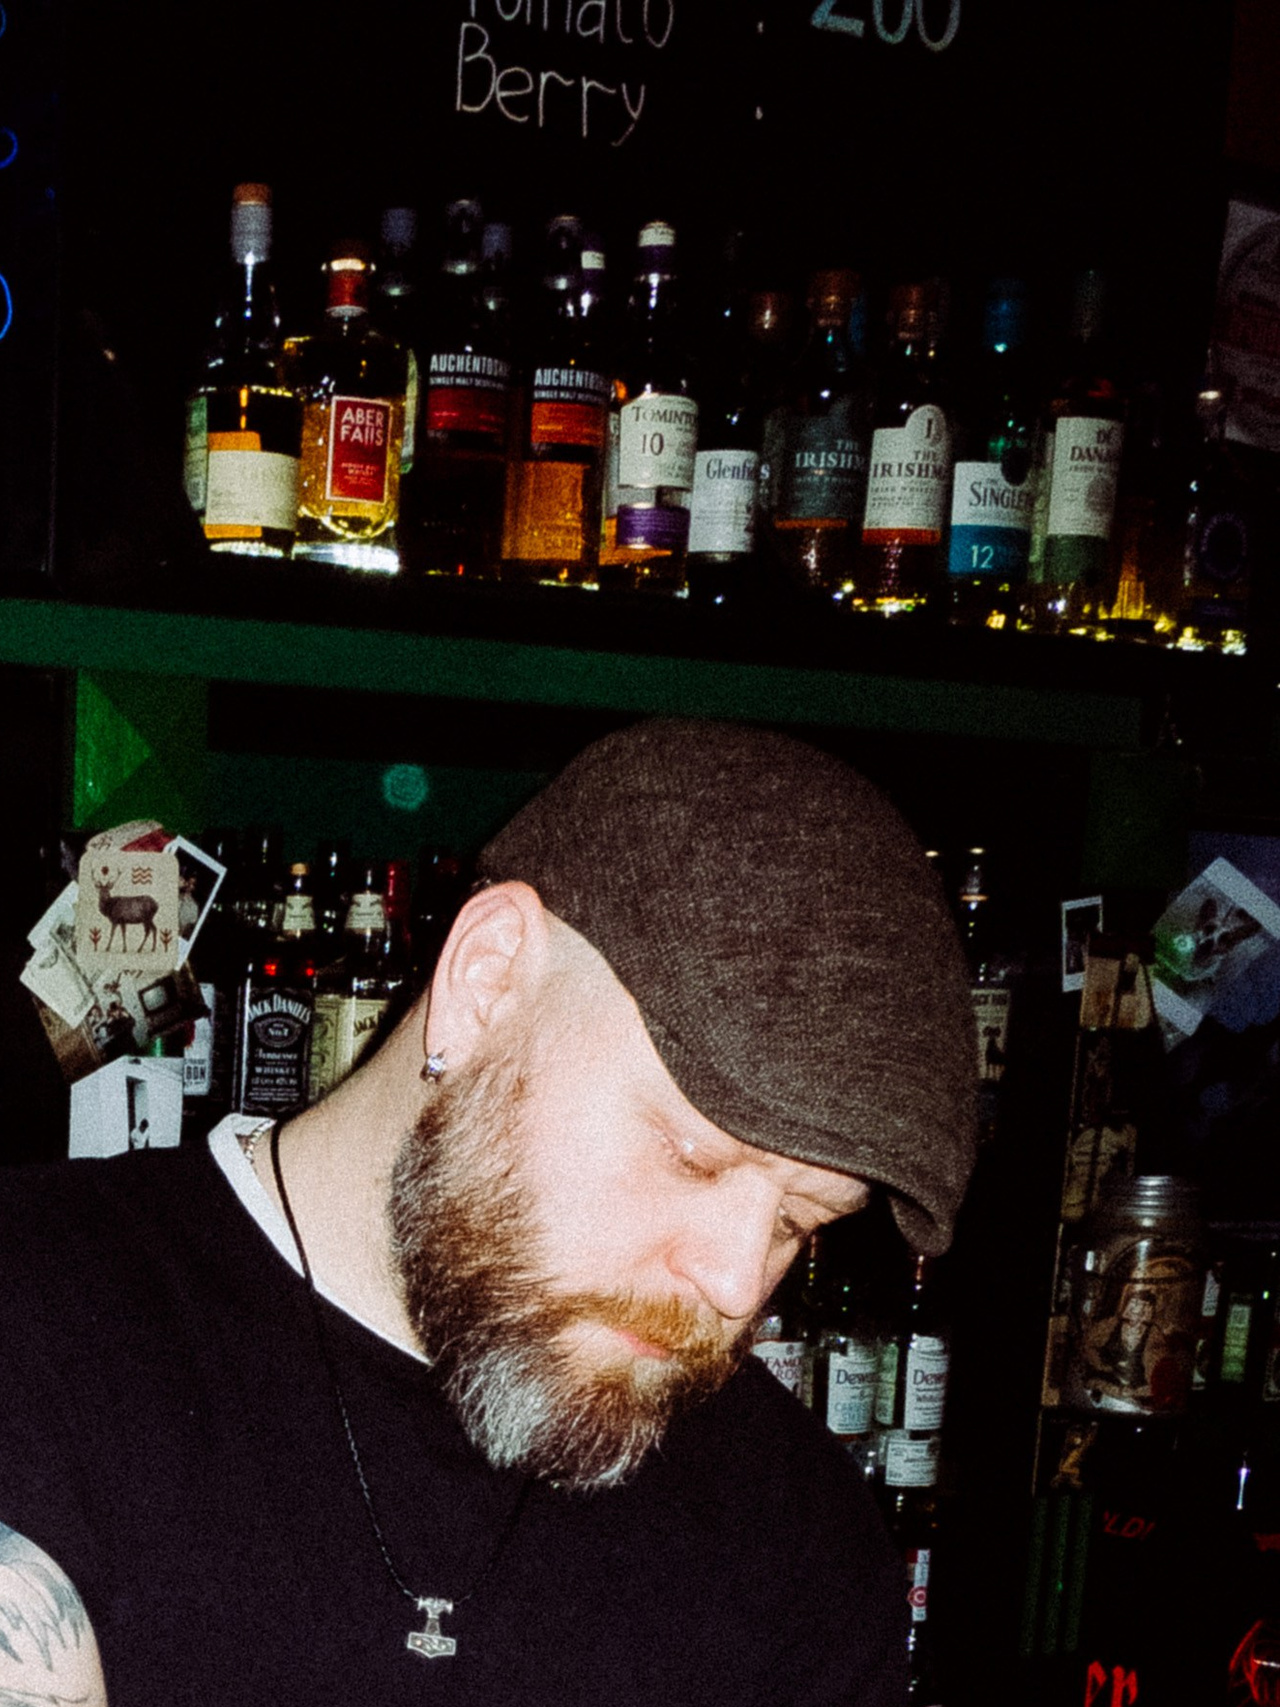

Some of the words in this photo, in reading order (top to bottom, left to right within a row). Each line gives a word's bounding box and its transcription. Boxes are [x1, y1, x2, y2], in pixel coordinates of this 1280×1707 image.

[455, 21, 646, 147] Berry
[341, 407, 385, 429] ABER
[640, 432, 665, 456] 10
[970, 544, 995, 570] 12
